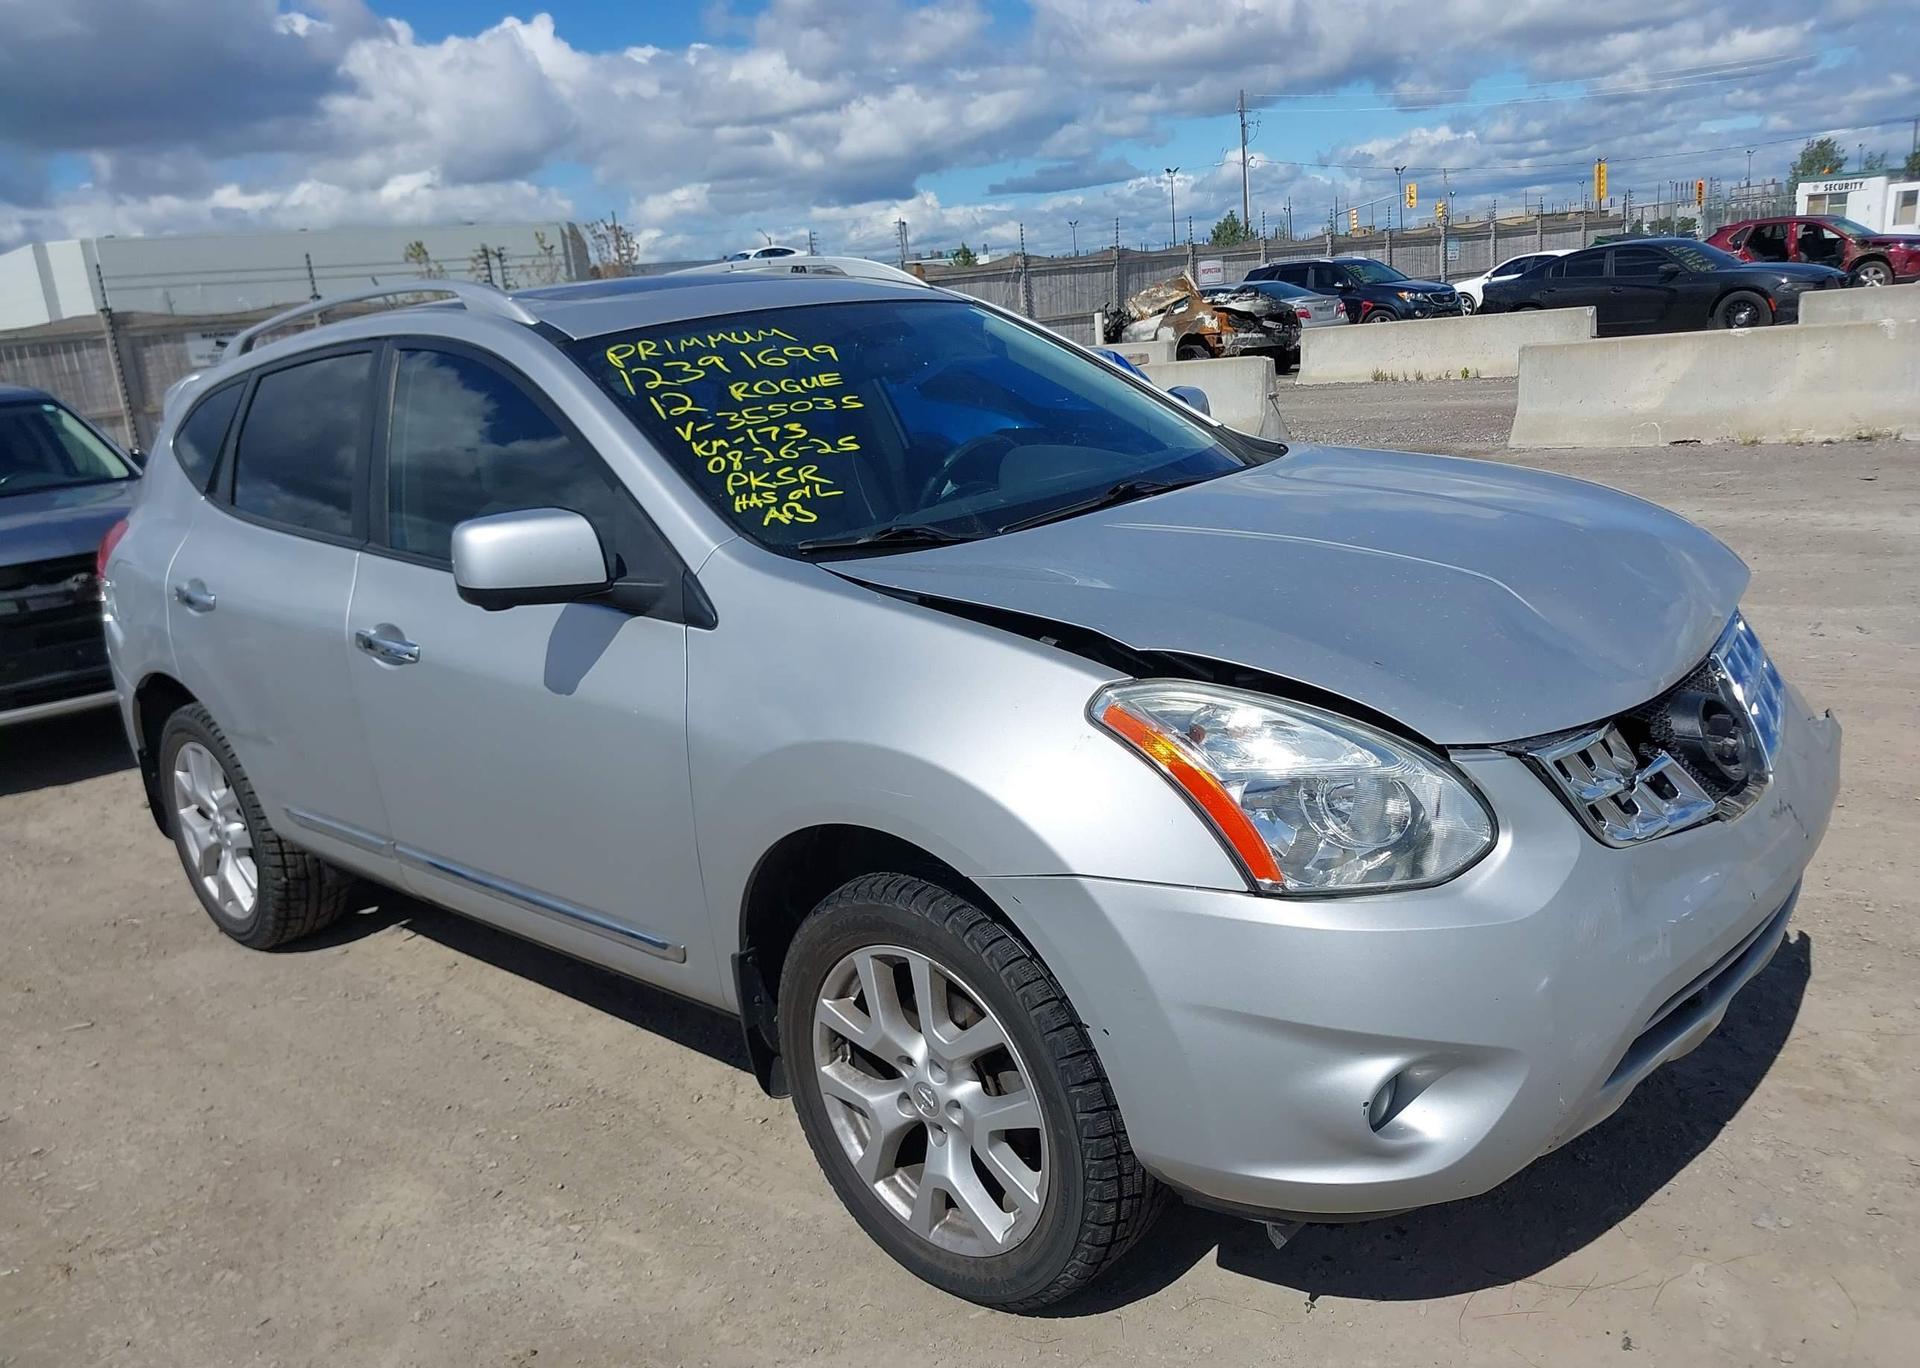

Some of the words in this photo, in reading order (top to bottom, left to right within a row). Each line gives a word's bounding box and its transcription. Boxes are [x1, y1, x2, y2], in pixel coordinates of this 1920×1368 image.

[1824, 182, 1864, 191] SECURITY
[606, 329, 799, 369] PRIMMUM
[651, 392, 708, 420] 12
[729, 373, 843, 401] ROGUE
[708, 436, 860, 473] 08-26-25
[727, 465, 834, 495] PKSR
[735, 492, 778, 512] HAS
